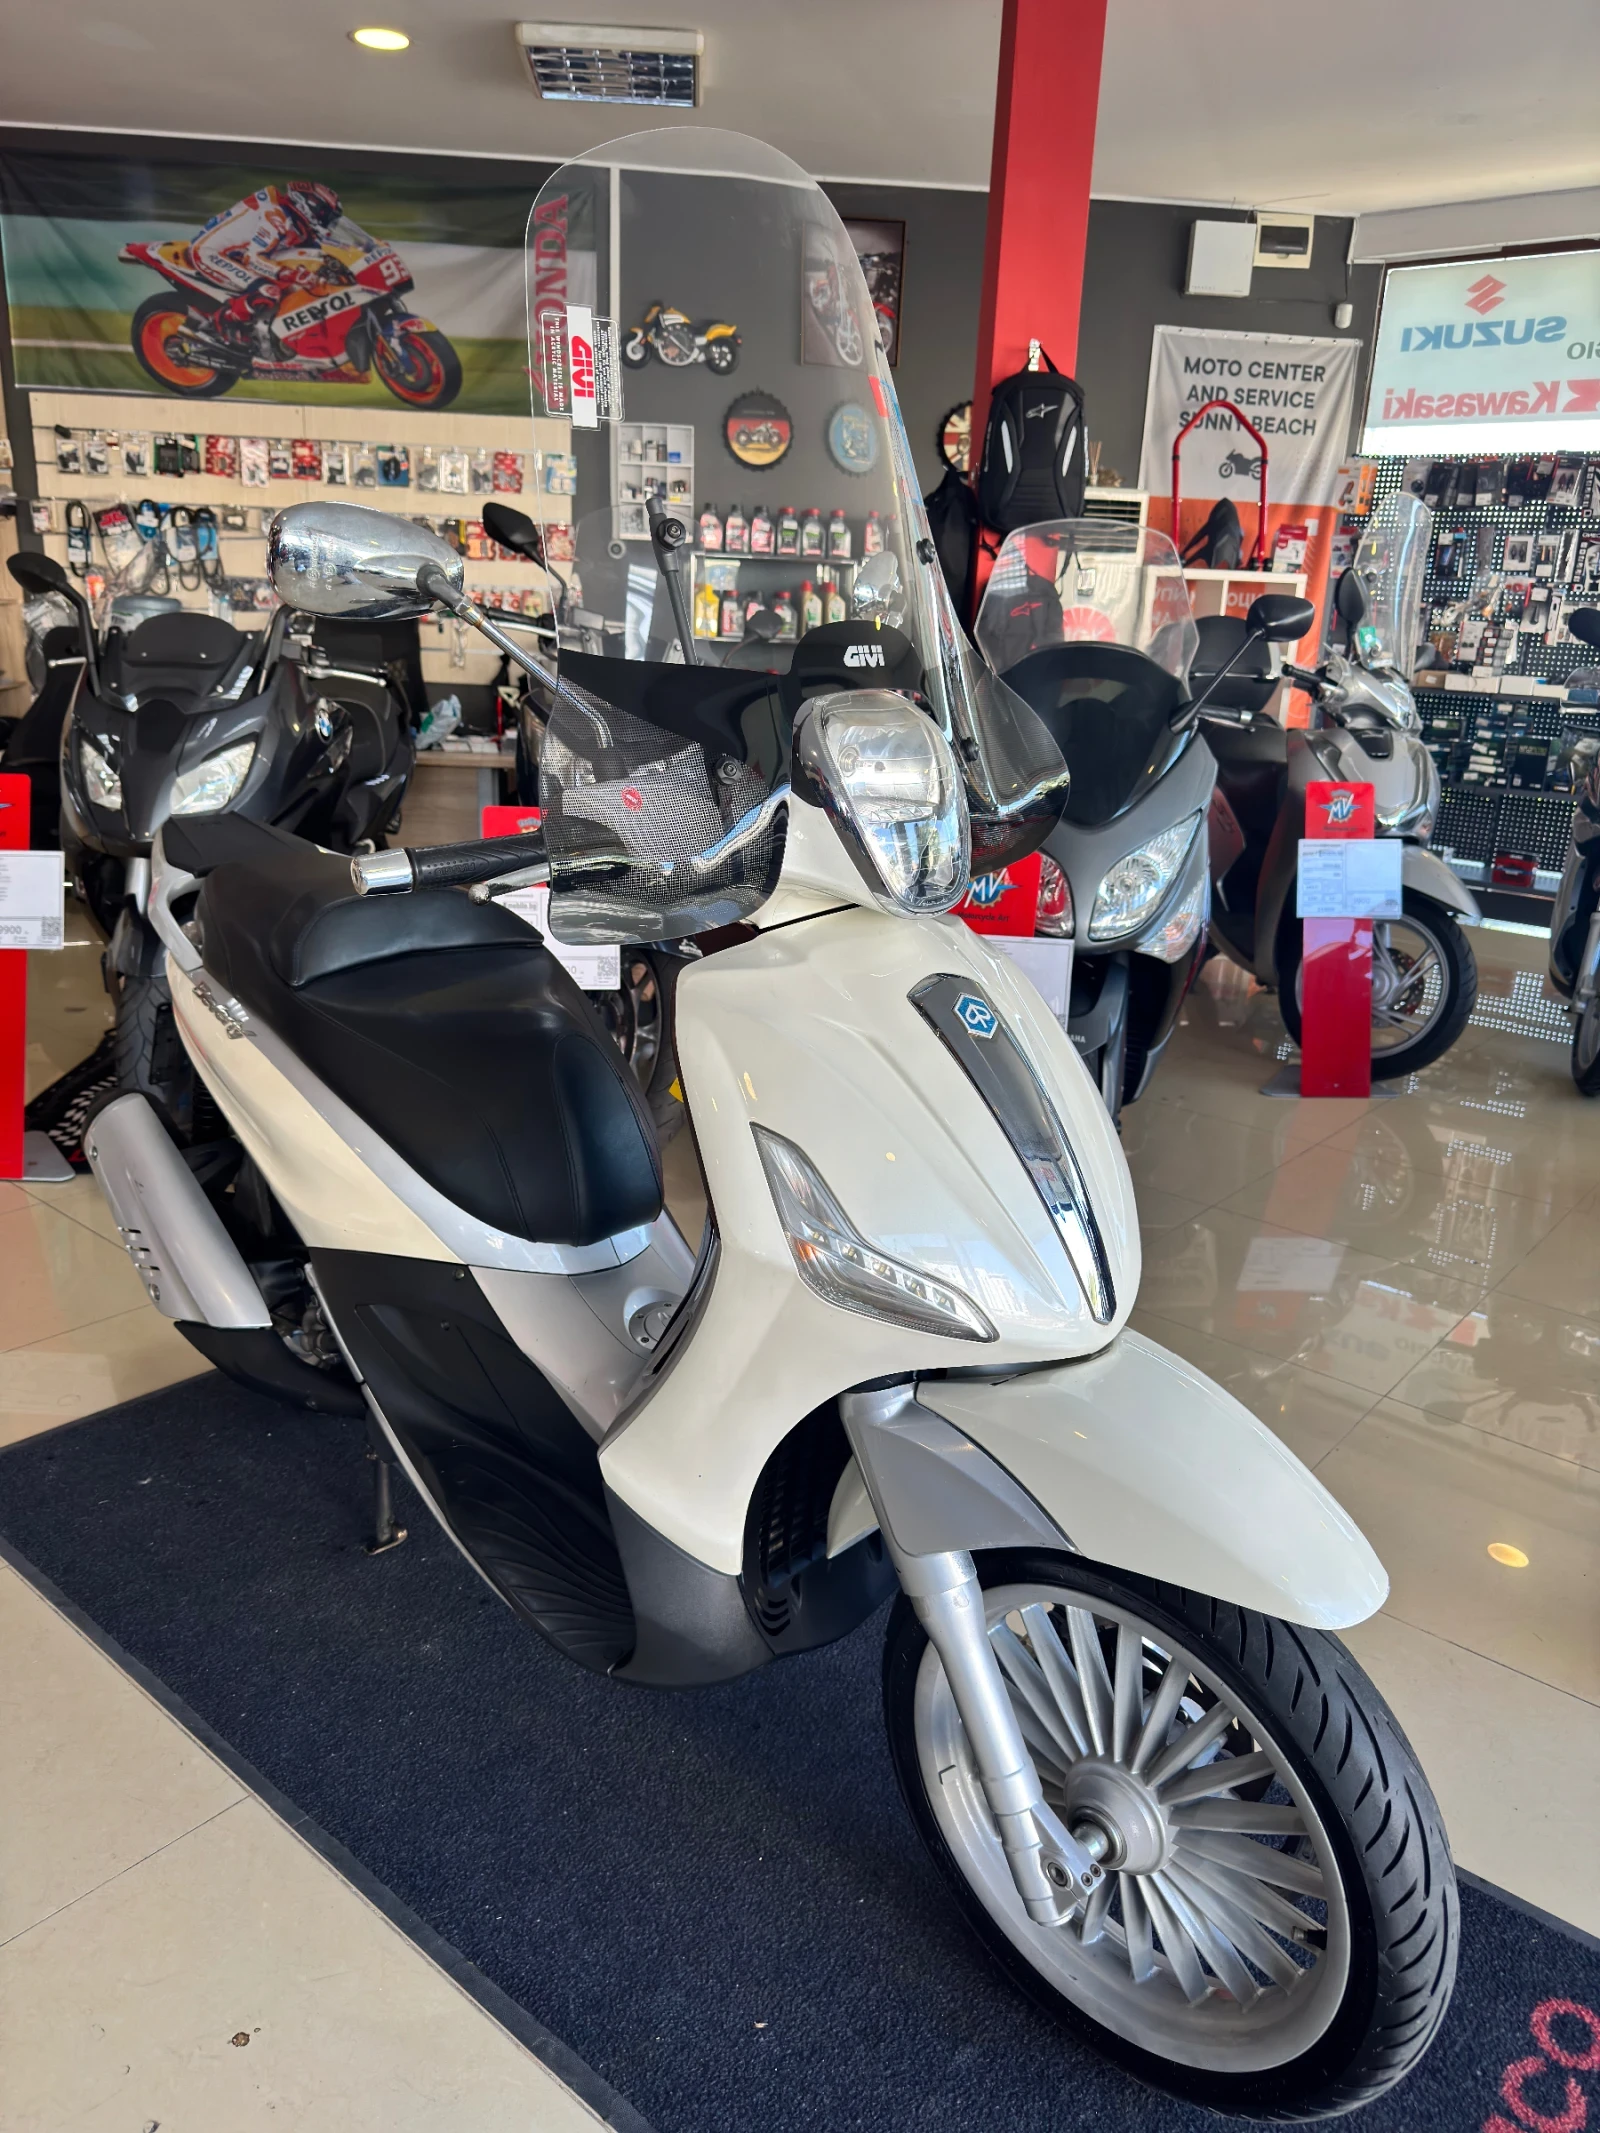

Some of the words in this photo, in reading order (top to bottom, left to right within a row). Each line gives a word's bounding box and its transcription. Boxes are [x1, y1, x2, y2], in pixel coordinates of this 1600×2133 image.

[533, 194, 569, 366] HONDA
[571, 335, 595, 398] GIVI
[1183, 356, 1242, 377] MOTO
[1248, 361, 1326, 382] CENTER
[1186, 385, 1229, 402] AND
[1234, 388, 1316, 409] SERVICE
[1251, 416, 1317, 436] BEACH
[843, 645, 885, 668] GIVI
[997, 914, 1010, 922] Art
